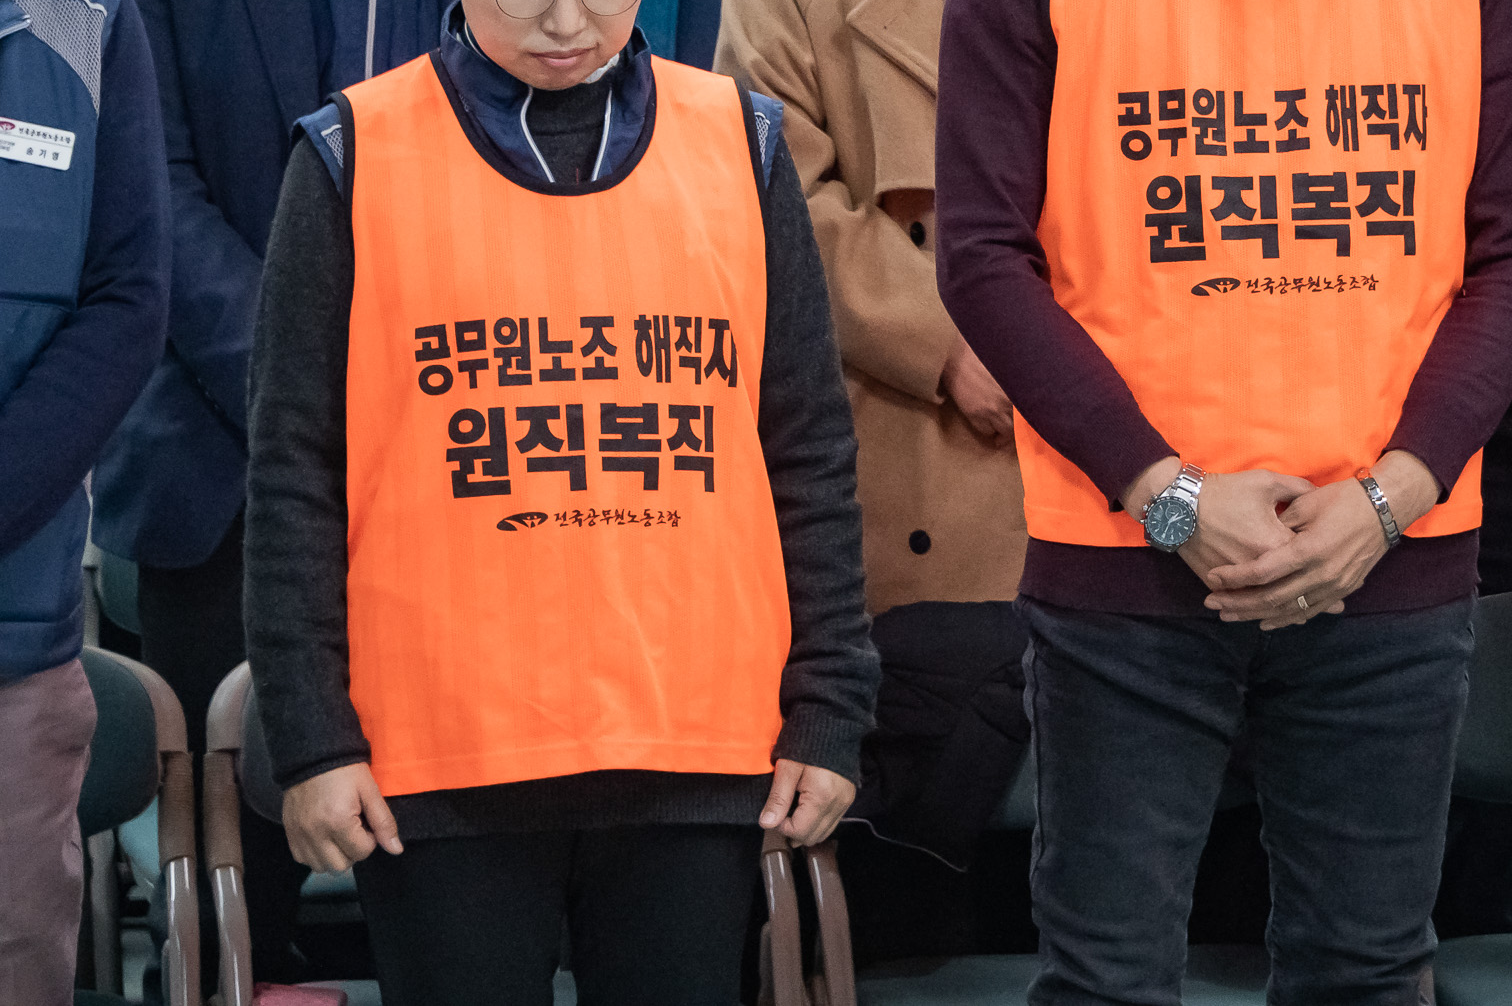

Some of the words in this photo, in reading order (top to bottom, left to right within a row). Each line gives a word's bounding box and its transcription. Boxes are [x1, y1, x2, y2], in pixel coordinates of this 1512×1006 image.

[1118, 88, 1310, 161] 공무원노조
[1325, 83, 1428, 152] 해직자
[1144, 170, 1416, 264] 원직복직
[1246, 274, 1379, 295] 전국공무원노동조합
[414, 316, 619, 396] 공무원노조
[633, 314, 738, 388] 해직자
[445, 402, 715, 499] 원직복직
[554, 508, 681, 528] 전국공무원노동조합
